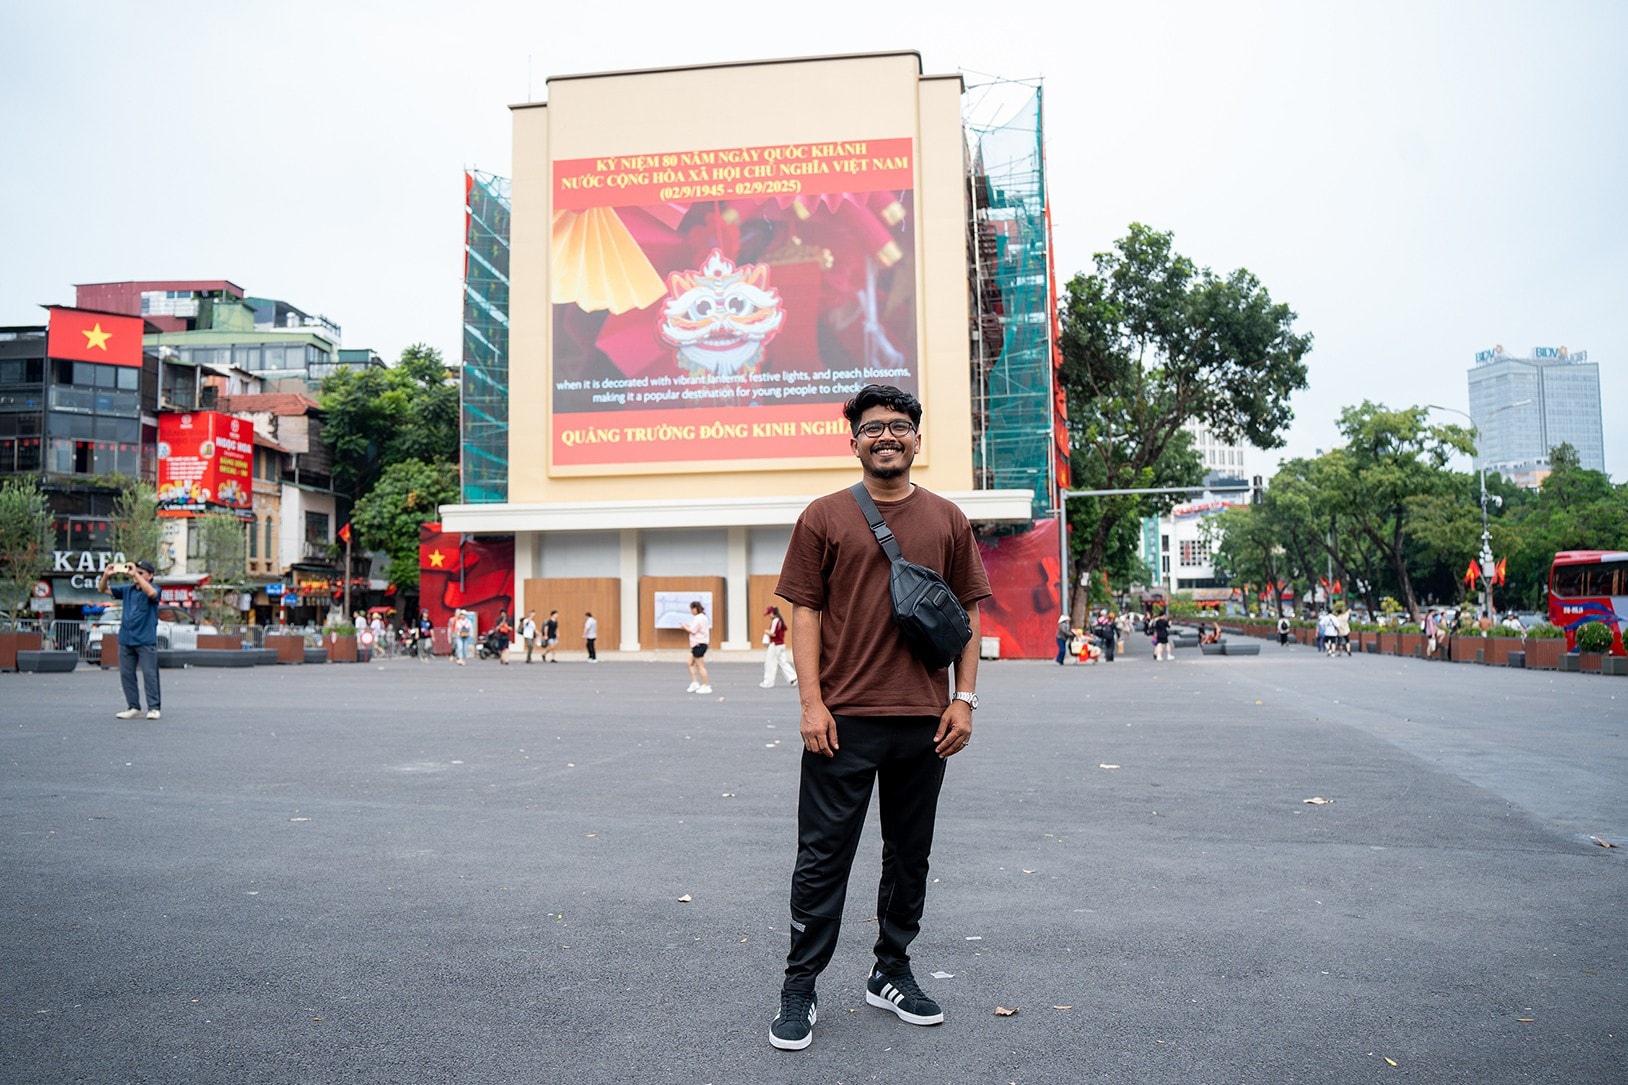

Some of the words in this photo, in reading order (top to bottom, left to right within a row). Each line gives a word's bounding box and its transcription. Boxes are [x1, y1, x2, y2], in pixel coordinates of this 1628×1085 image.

[621, 155, 659, 171] NIỆM
[662, 155, 678, 168] 80
[681, 151, 715, 166] NĂM
[718, 147, 759, 163] NGÀY
[763, 144, 808, 161] QUỐC
[811, 141, 867, 158] KHÁNH
[561, 173, 604, 190] NƯỚC
[606, 172, 649, 189] CỘNG
[652, 170, 686, 184] HÒA
[688, 169, 709, 182] XÃ
[712, 166, 741, 182] HỘI
[743, 162, 776, 177] CHỦ
[779, 159, 830, 176] NGHĨA
[832, 158, 870, 174] VIỆT
[872, 156, 908, 171] NAM
[660, 184, 725, 201] (02/9/1945
[735, 180, 801, 195] 02/9/2025)
[1535, 347, 1560, 358] BIDV
[556, 380, 582, 391] when
[583, 379, 591, 390] it
[592, 379, 600, 390] is
[601, 376, 649, 390] decorated
[650, 375, 672, 387] with
[673, 374, 705, 386] vibrant
[707, 374, 747, 385] lanterns,
[749, 371, 781, 383] festive
[782, 369, 811, 383] lights,
[812, 368, 831, 380] and
[832, 367, 862, 381] peach
[863, 366, 911, 379] blossoms,
[592, 391, 626, 404] making
[626, 391, 635, 402] it
[635, 393, 643, 402] a
[643, 390, 680, 404] popular
[681, 387, 735, 400] destination
[736, 386, 751, 398] for
[751, 387, 782, 400] young
[783, 384, 817, 397] people
[818, 384, 831, 395] to
[561, 426, 620, 447] QUẢNG
[624, 423, 695, 442] TRƯỜNG
[699, 420, 748, 440] ĐÔNG
[752, 422, 796, 438] KINH
[71, 574, 105, 589] Caf
